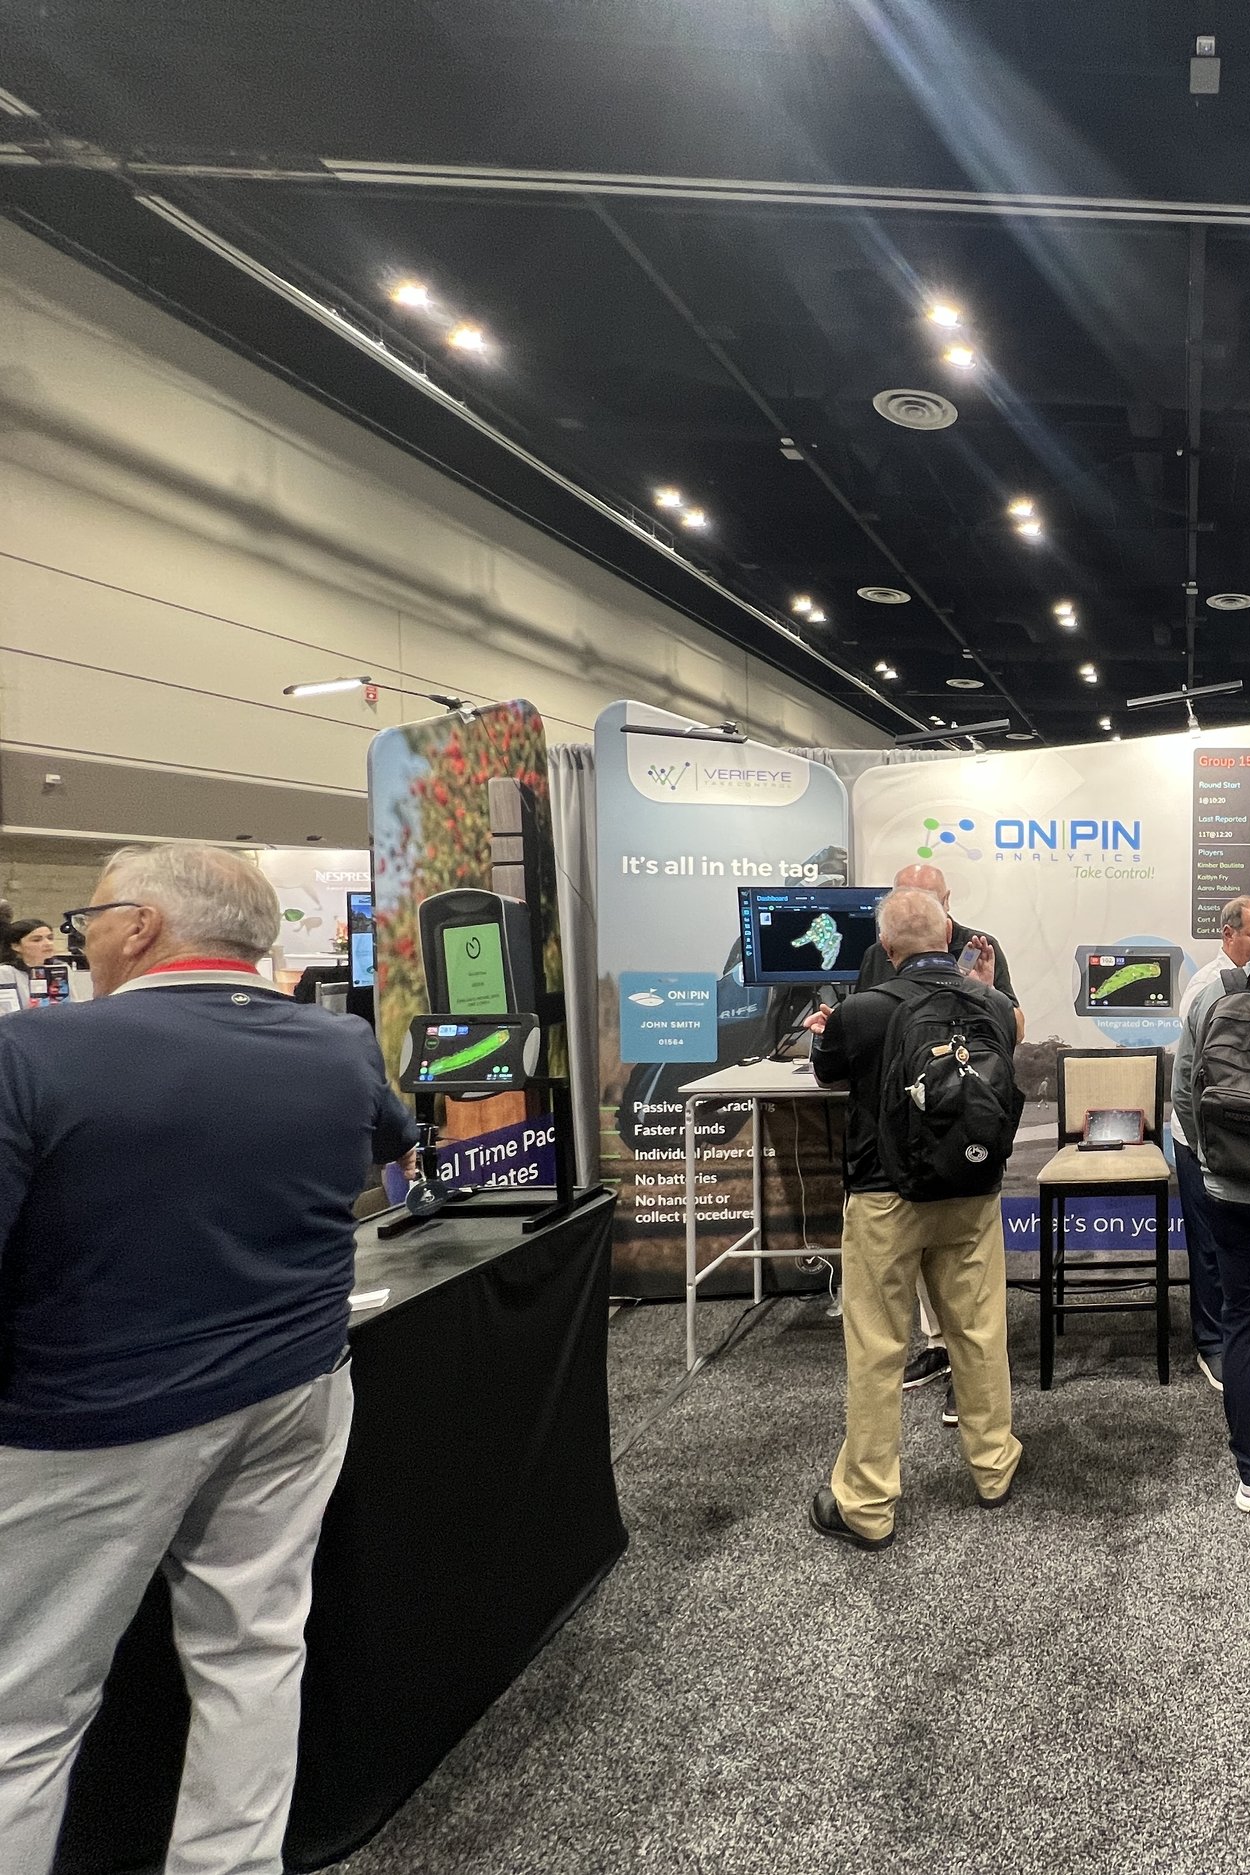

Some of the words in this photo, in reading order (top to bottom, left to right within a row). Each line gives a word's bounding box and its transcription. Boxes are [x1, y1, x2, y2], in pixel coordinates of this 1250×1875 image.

[1199, 755, 1235, 769] Group
[704, 768, 792, 783] VERIFEYE
[1199, 815, 1214, 823] Last
[1215, 815, 1247, 824] Reported
[995, 853, 1141, 862] ANALYTICS
[1198, 849, 1224, 857] Players
[664, 856, 694, 876] all
[702, 856, 725, 876] in
[731, 858, 773, 878] the
[1074, 865, 1102, 879] Take
[1104, 865, 1155, 880] Control!
[641, 1021, 668, 1029] JOHN
[671, 1021, 701, 1029] SMITH
[1097, 1020, 1140, 1028] Integrated
[633, 1101, 683, 1113] Passive
[635, 1124, 677, 1136] Faster
[679, 1123, 726, 1135] runds
[465, 1140, 518, 1172] Time
[703, 1146, 744, 1162] player
[746, 1147, 776, 1158] dta
[635, 1174, 655, 1186] No
[658, 1173, 718, 1185] battries
[635, 1195, 656, 1206] No
[715, 1195, 730, 1205] or
[635, 1211, 680, 1224] collect
[1093, 1217, 1124, 1233] on
